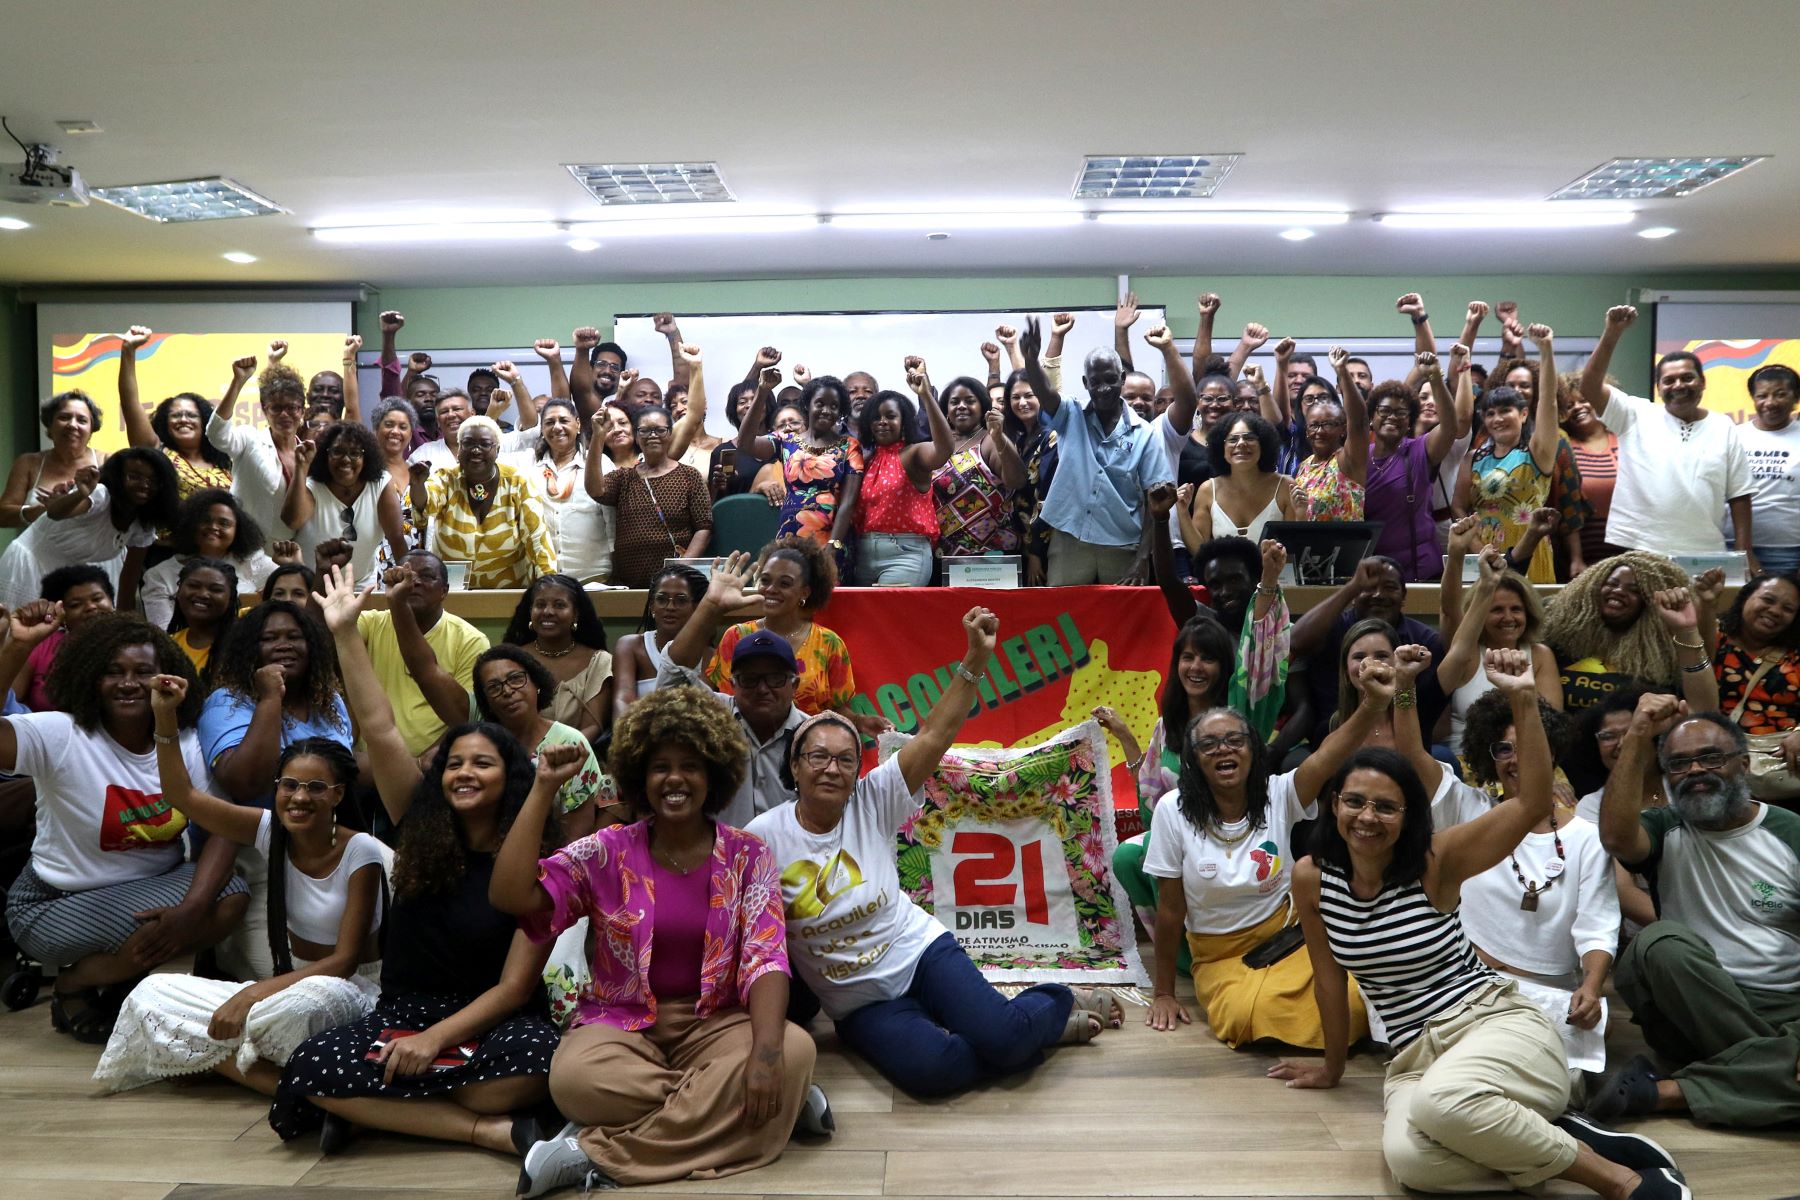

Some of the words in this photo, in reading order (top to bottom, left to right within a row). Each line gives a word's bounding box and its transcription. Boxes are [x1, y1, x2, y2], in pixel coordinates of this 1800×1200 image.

[952, 832, 1049, 925] 21
[955, 910, 1016, 930] DIAS
[808, 935, 858, 958] Luta
[957, 937, 970, 946] DE
[973, 935, 1029, 945] ATIVISMO
